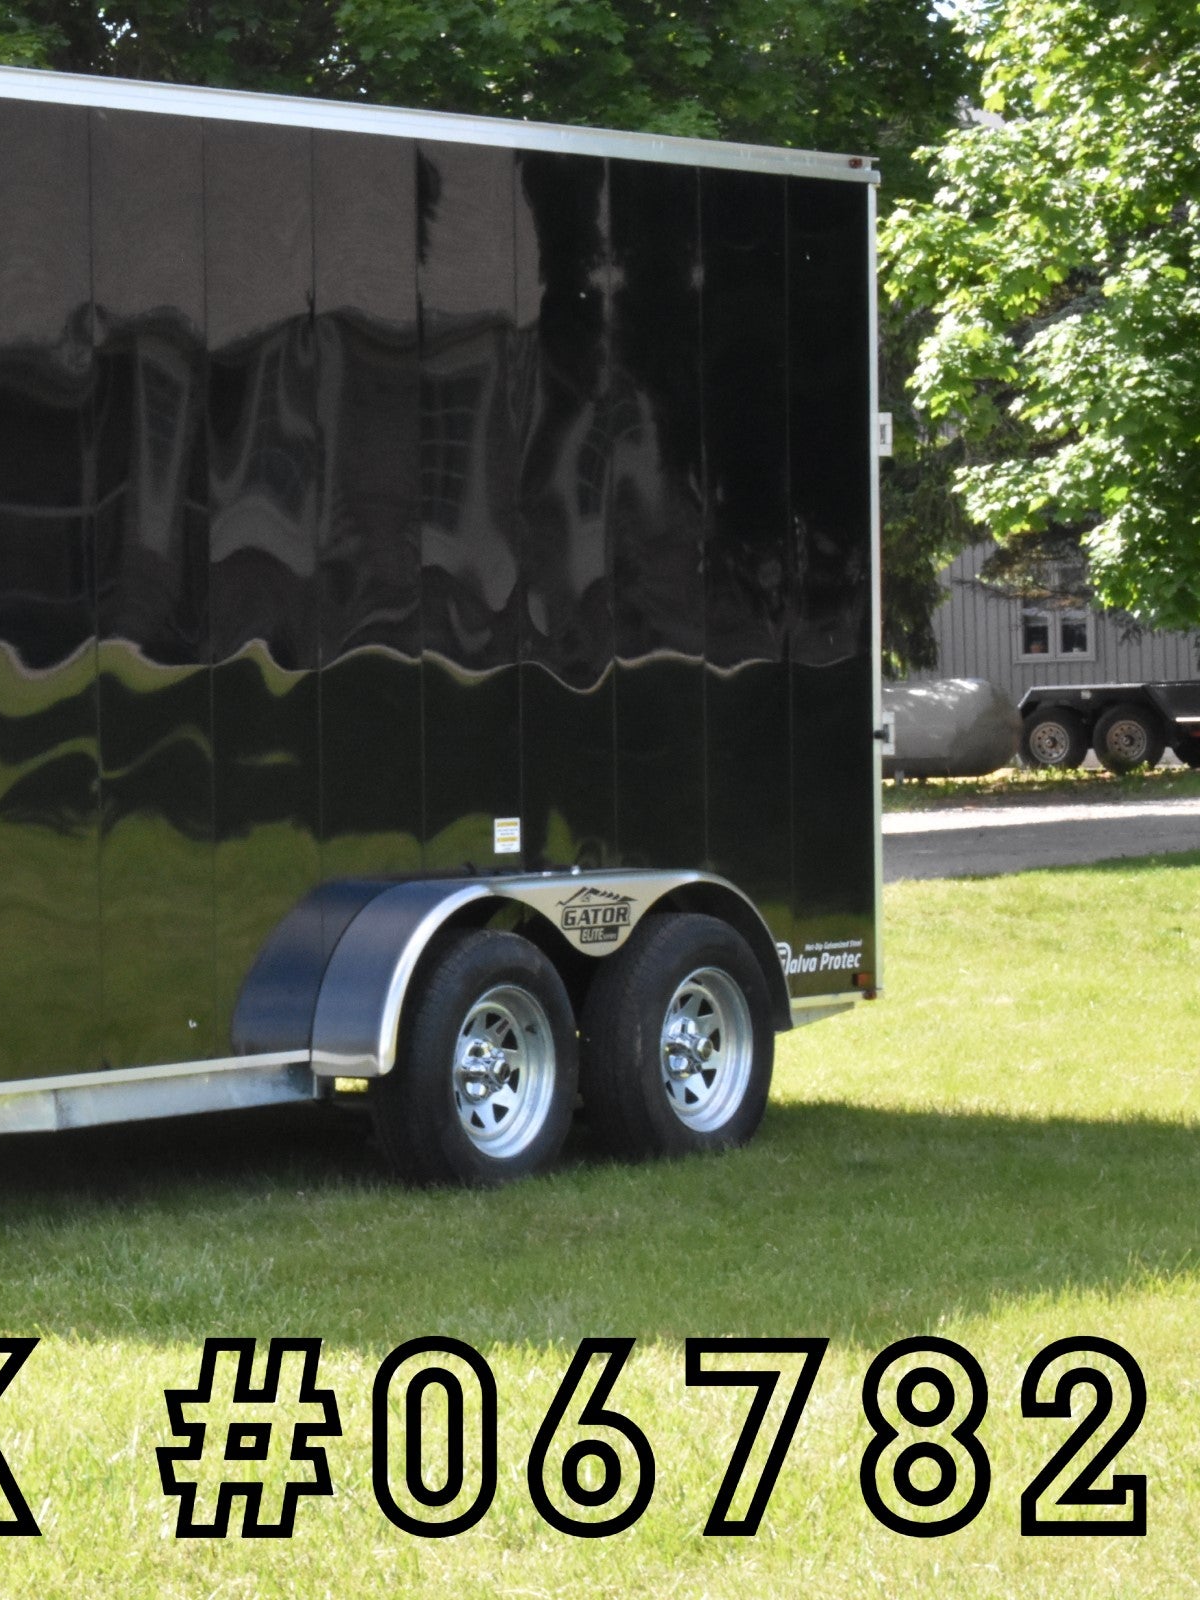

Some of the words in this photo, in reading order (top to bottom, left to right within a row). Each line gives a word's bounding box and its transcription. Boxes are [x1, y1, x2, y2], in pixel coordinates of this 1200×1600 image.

[564, 907, 629, 926] GATOR
[582, 928, 604, 940] ELITE
[820, 952, 862, 971] Protec
